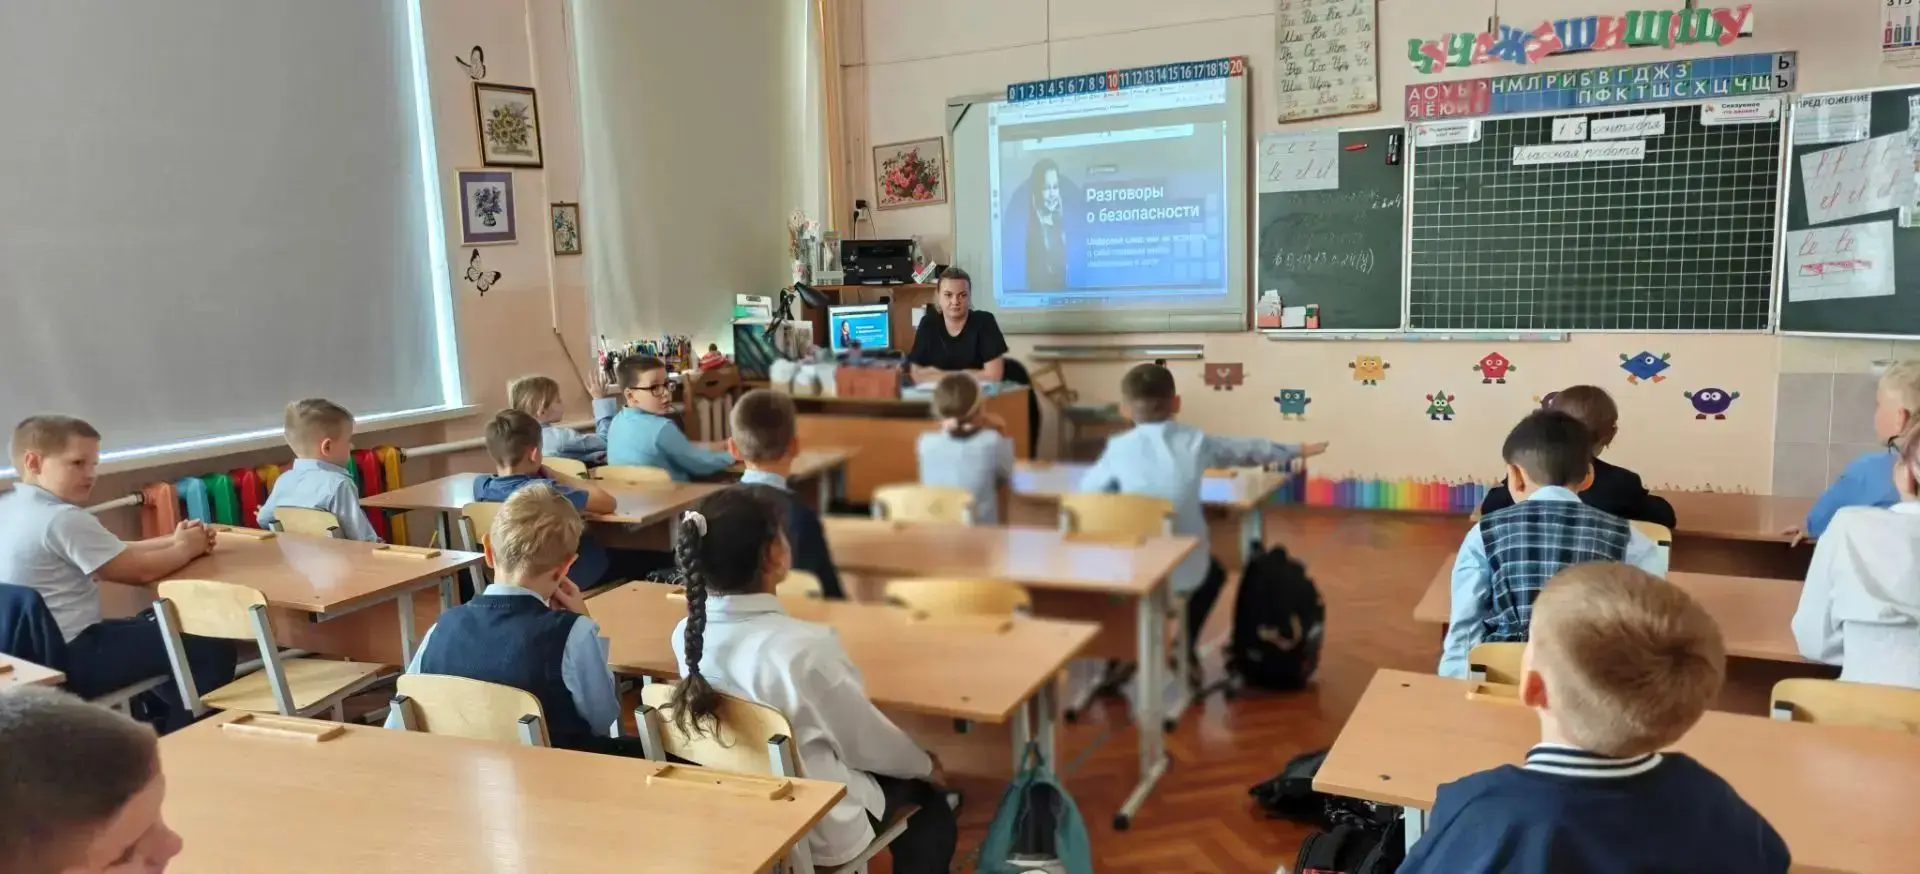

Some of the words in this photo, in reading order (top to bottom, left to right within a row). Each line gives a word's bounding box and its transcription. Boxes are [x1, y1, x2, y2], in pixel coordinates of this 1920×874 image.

[1010, 88, 1016, 100] 0
[1020, 86, 1024, 98] 1
[1029, 86, 1034, 98] 2
[1039, 84, 1044, 96] 3
[1048, 82, 1055, 95] 4
[1059, 82, 1064, 94] 5
[1068, 80, 1074, 93] 6
[1079, 79, 1085, 91] 7
[1089, 78, 1095, 90] 8
[1099, 76, 1105, 89] 9
[1108, 74, 1117, 88] 10
[1120, 72, 1129, 86] 11
[1132, 71, 1142, 85] 12
[1145, 70, 1154, 83] 13
[1156, 68, 1167, 82] 14
[1168, 67, 1178, 80] 15
[1181, 66, 1192, 79] 16
[1194, 64, 1204, 78] 17
[1206, 63, 1216, 76] 18
[1219, 61, 1229, 75] 19
[1231, 60, 1242, 74] 20
[1086, 186, 1164, 203] Разговоры
[1086, 212, 1094, 223] о
[1099, 205, 1200, 222] безопасности
